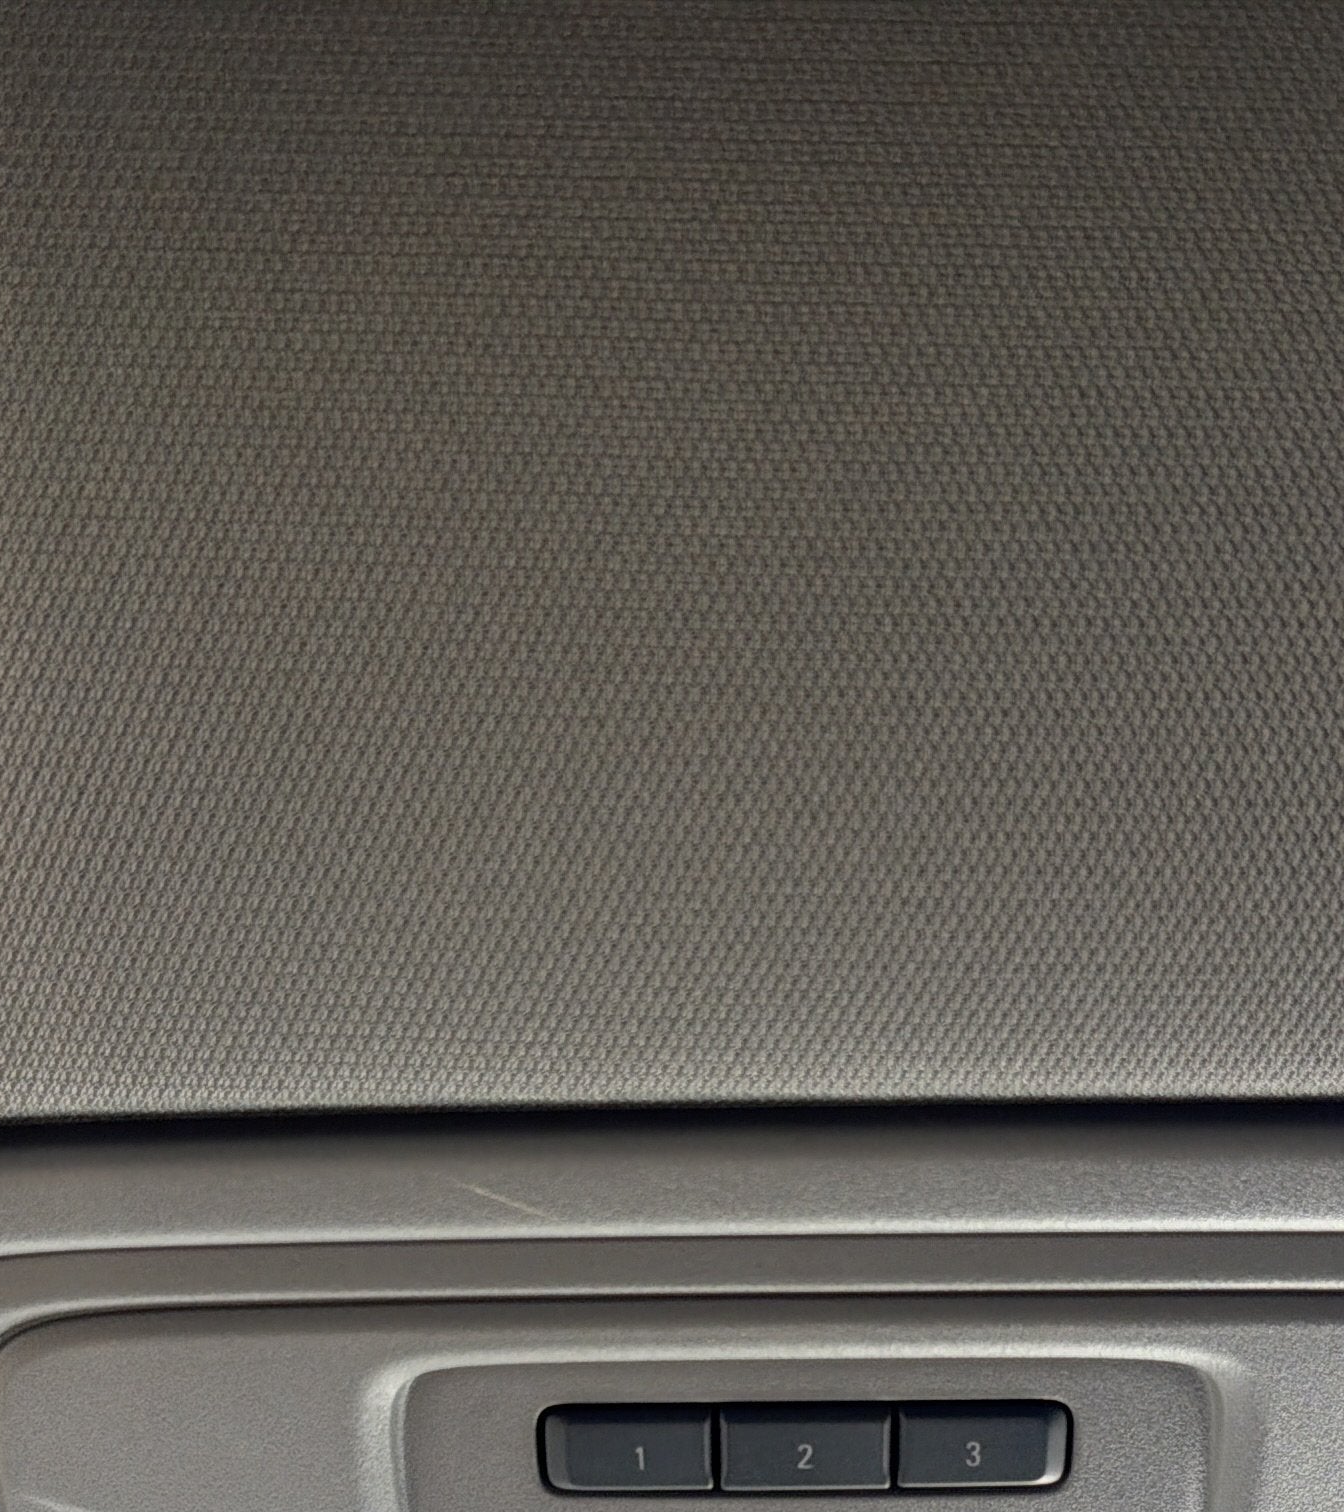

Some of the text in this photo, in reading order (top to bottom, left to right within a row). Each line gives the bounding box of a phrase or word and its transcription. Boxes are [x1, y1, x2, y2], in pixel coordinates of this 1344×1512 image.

[635, 1446, 645, 1470] 1
[797, 1444, 814, 1469] 2
[965, 1441, 981, 1466] 3
